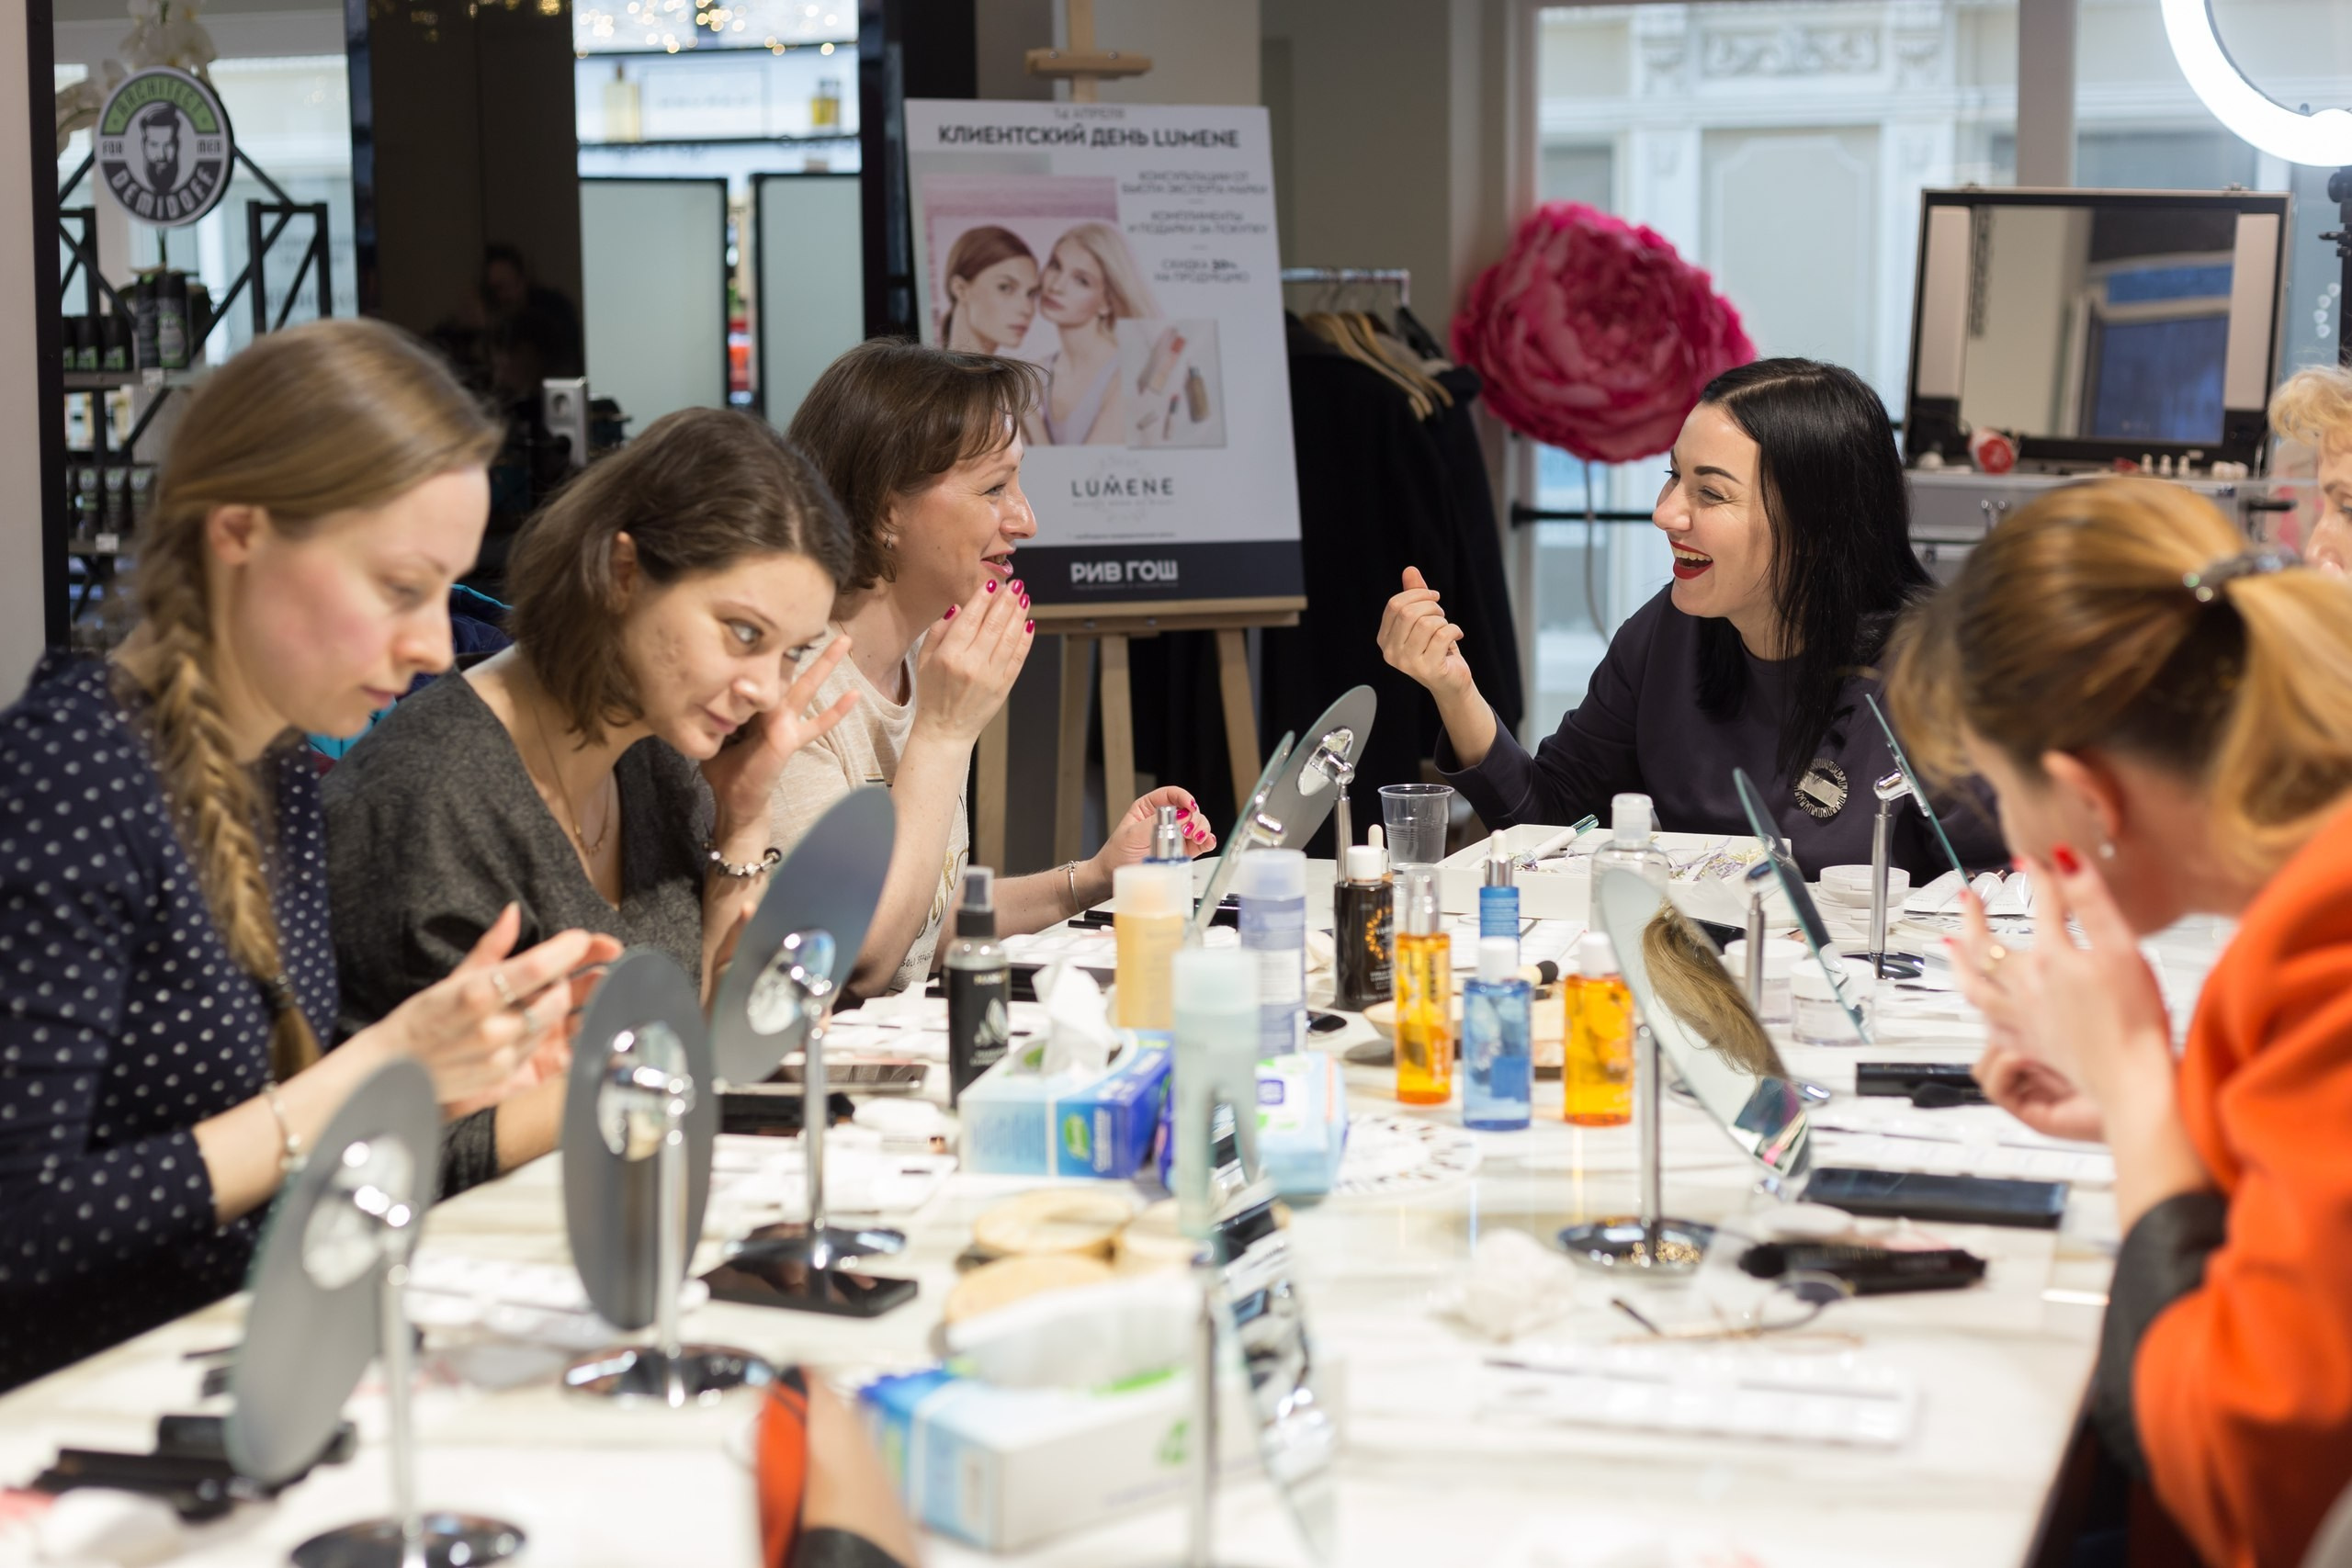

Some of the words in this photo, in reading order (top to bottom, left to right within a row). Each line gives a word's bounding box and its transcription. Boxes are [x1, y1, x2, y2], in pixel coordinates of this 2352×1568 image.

[115, 76, 204, 118] ARCHITECT
[102, 140, 124, 154] FOR
[197, 139, 221, 154] MEN
[938, 123, 1086, 144] КЛИЕНТСКИЙ
[1091, 127, 1148, 149] ДЕНЬ
[1152, 129, 1239, 148] LUMENE
[110, 165, 215, 220] DEMIDOFF
[1070, 474, 1175, 497] LUMENE
[1070, 561, 1122, 583] РИВ
[1125, 559, 1178, 581] ГОШ
